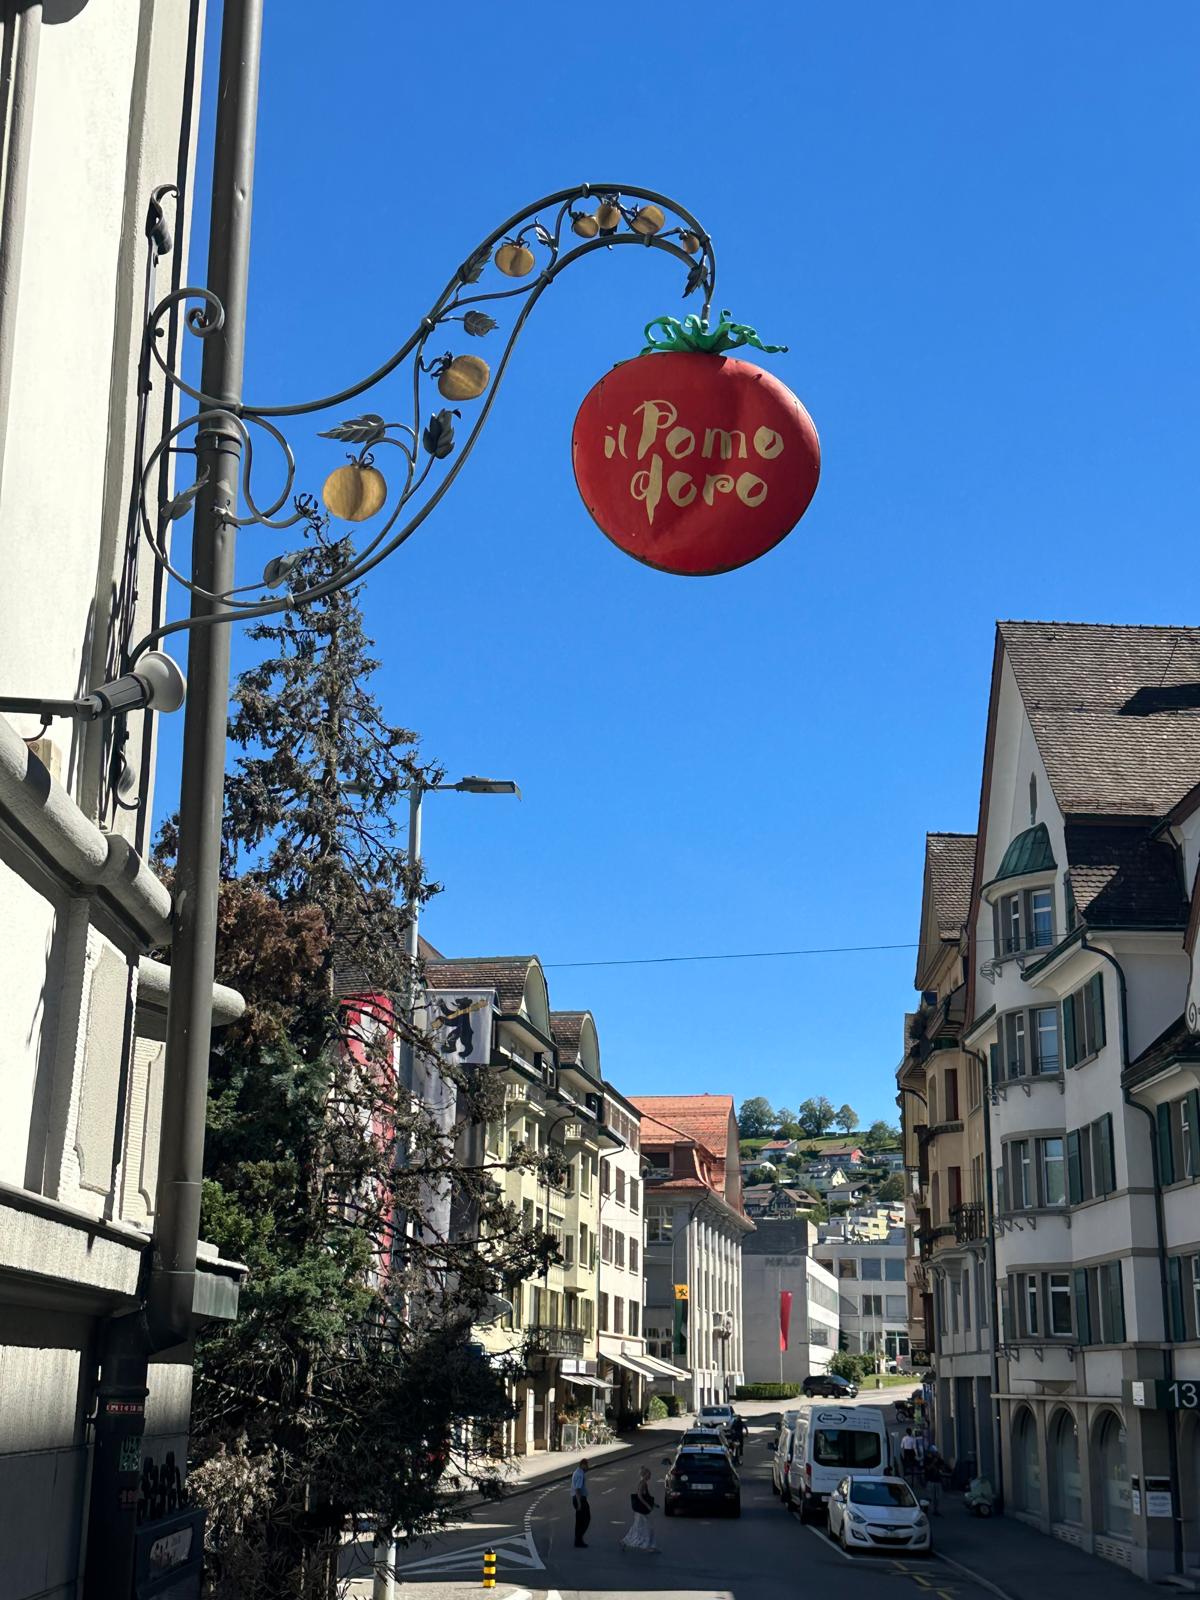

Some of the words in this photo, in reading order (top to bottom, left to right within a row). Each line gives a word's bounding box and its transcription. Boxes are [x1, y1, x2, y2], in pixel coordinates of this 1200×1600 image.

[604, 423, 628, 459] il
[633, 400, 784, 460] Pomo
[630, 453, 768, 526] doro
[1168, 1382, 1198, 1408] 13
